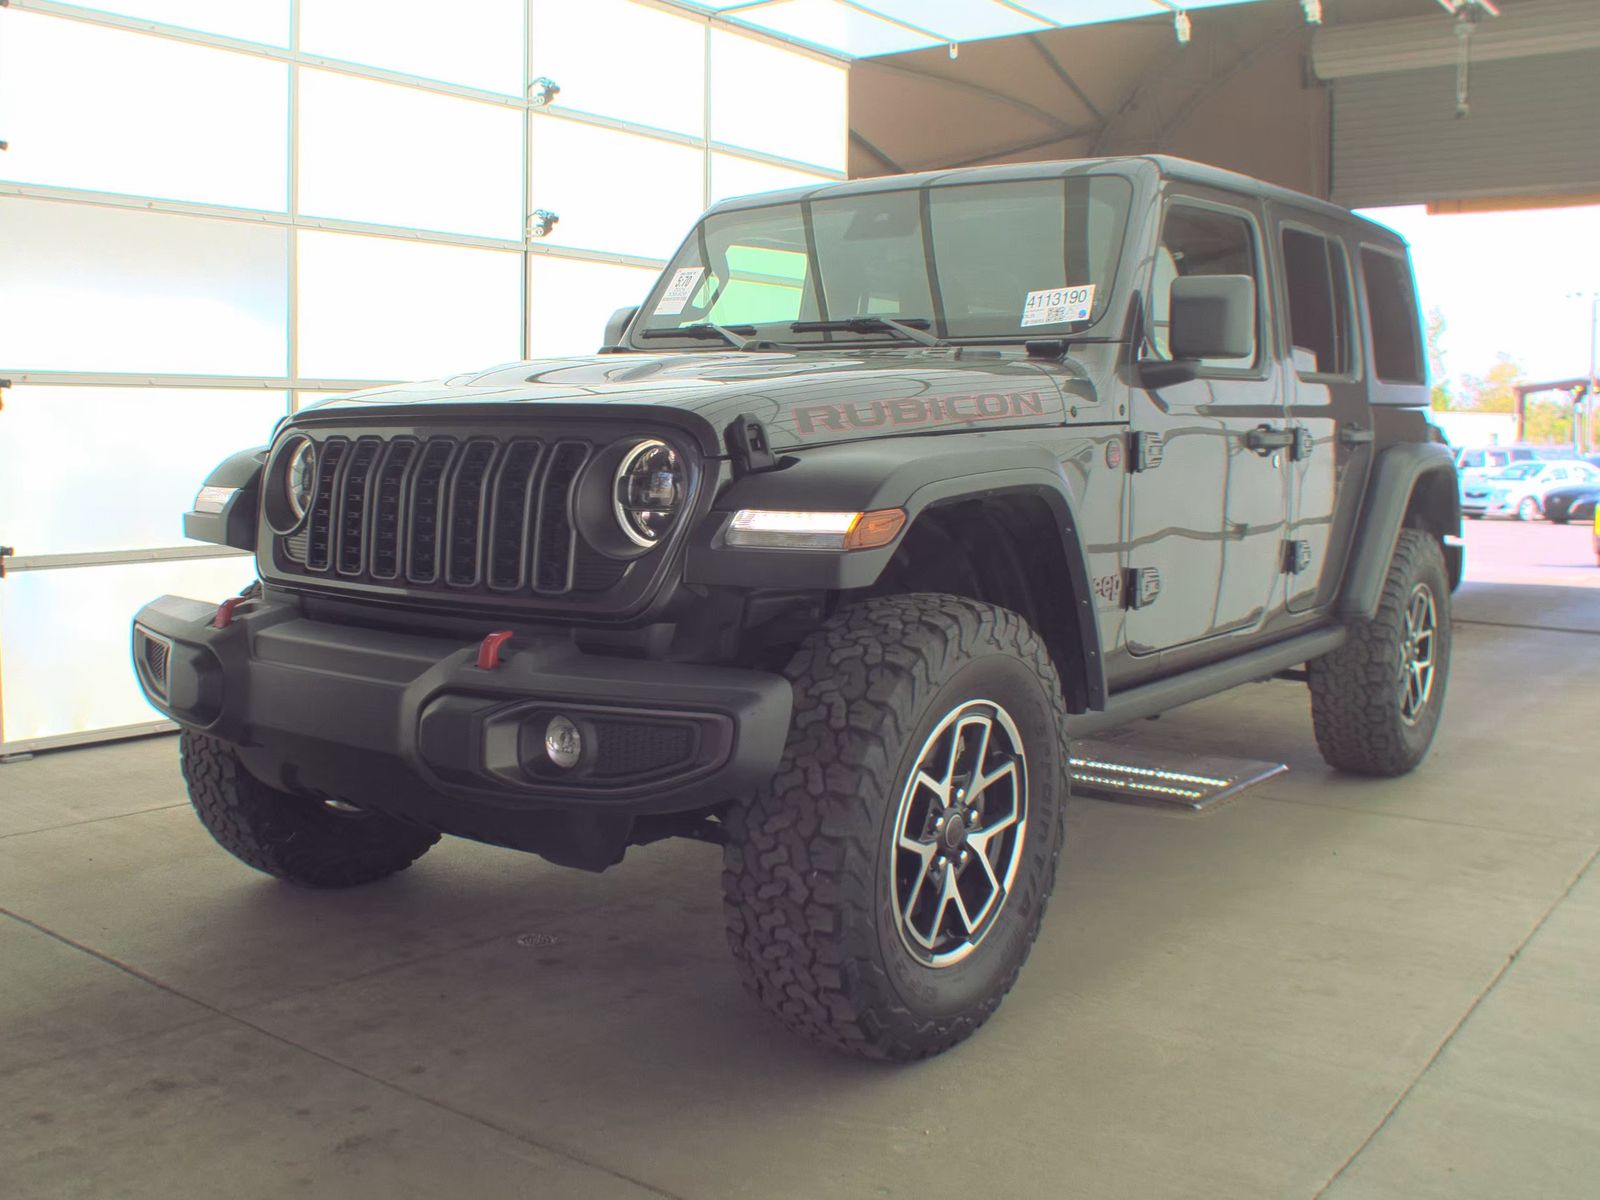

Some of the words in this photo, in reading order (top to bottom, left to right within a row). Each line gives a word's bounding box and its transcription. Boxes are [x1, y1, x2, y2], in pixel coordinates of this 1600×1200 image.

[1027, 289, 1088, 308] 4113190
[792, 392, 1044, 435] RUBICON
[1092, 574, 1121, 601] eep
